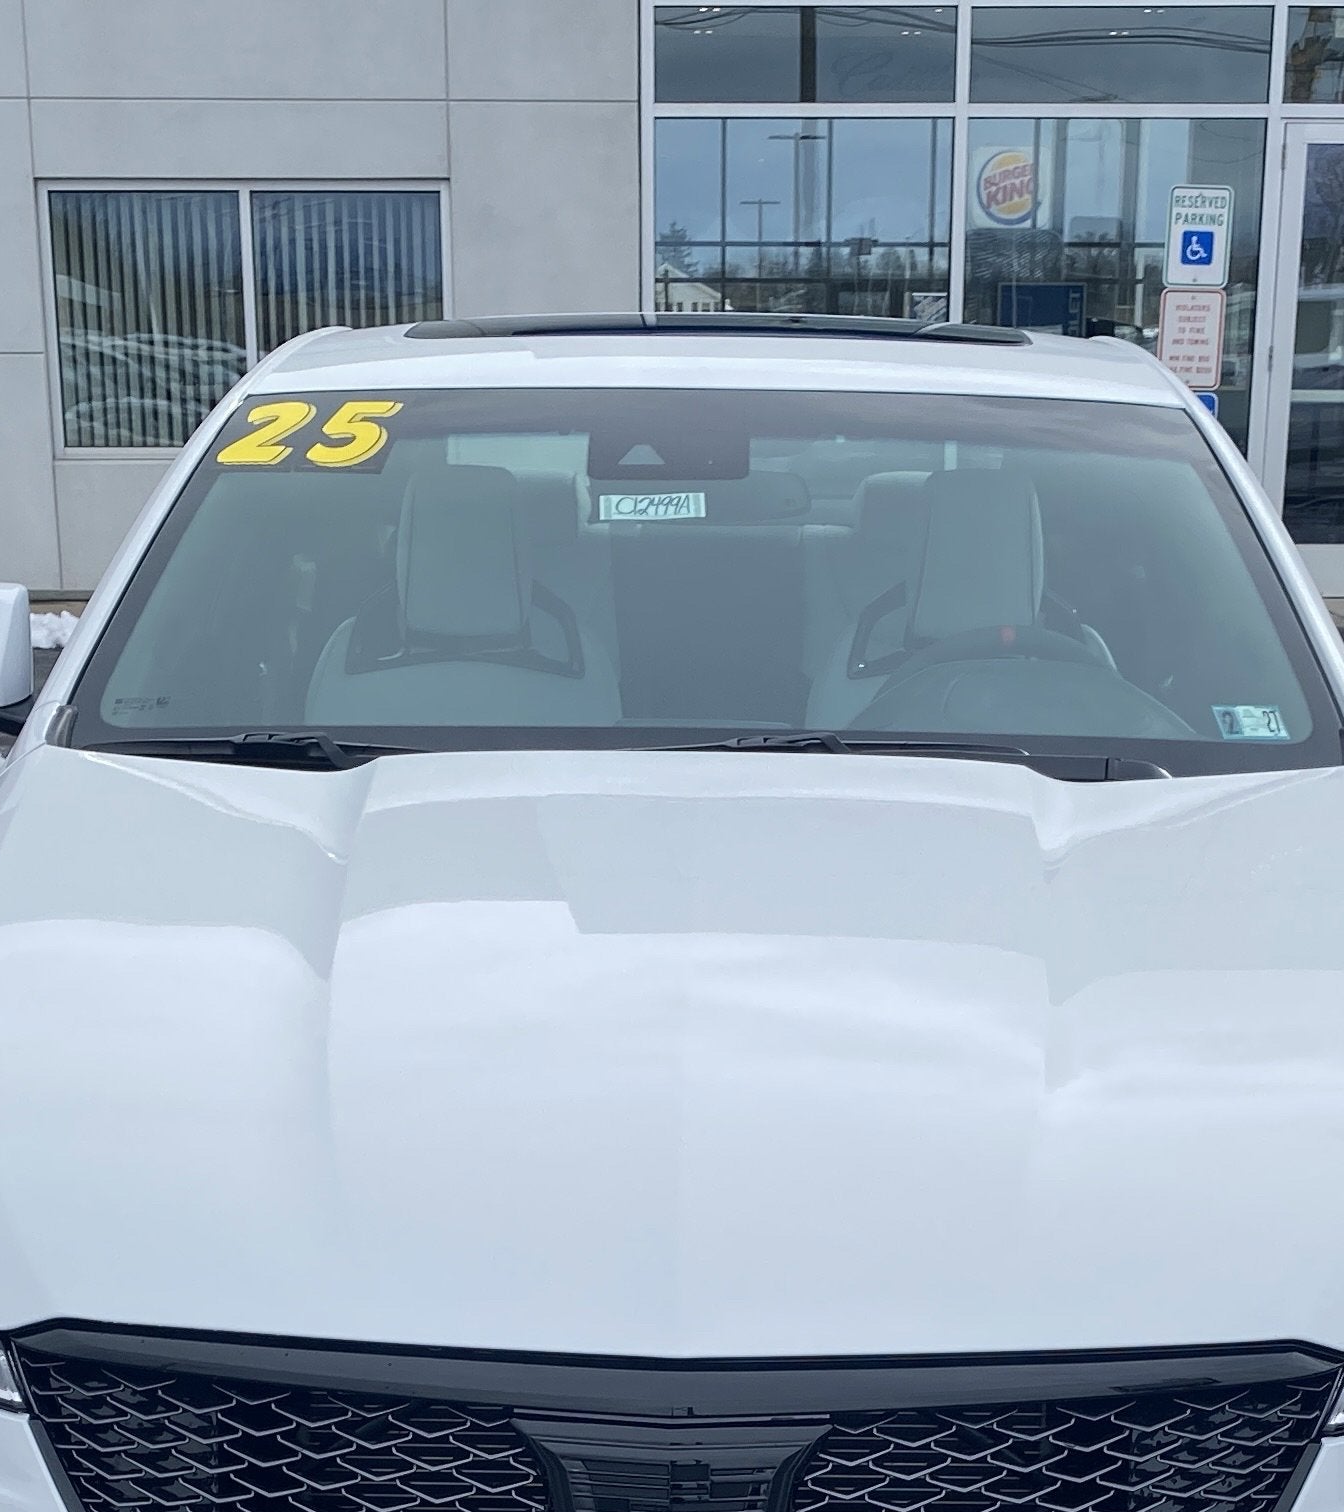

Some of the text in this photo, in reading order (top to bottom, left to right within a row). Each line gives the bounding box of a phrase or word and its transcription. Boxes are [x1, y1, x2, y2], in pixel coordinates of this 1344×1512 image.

[983, 165, 1032, 191] BURGE
[1174, 195, 1227, 209] RESERVED
[1174, 212, 1225, 226] PARKING
[216, 401, 404, 467] 25
